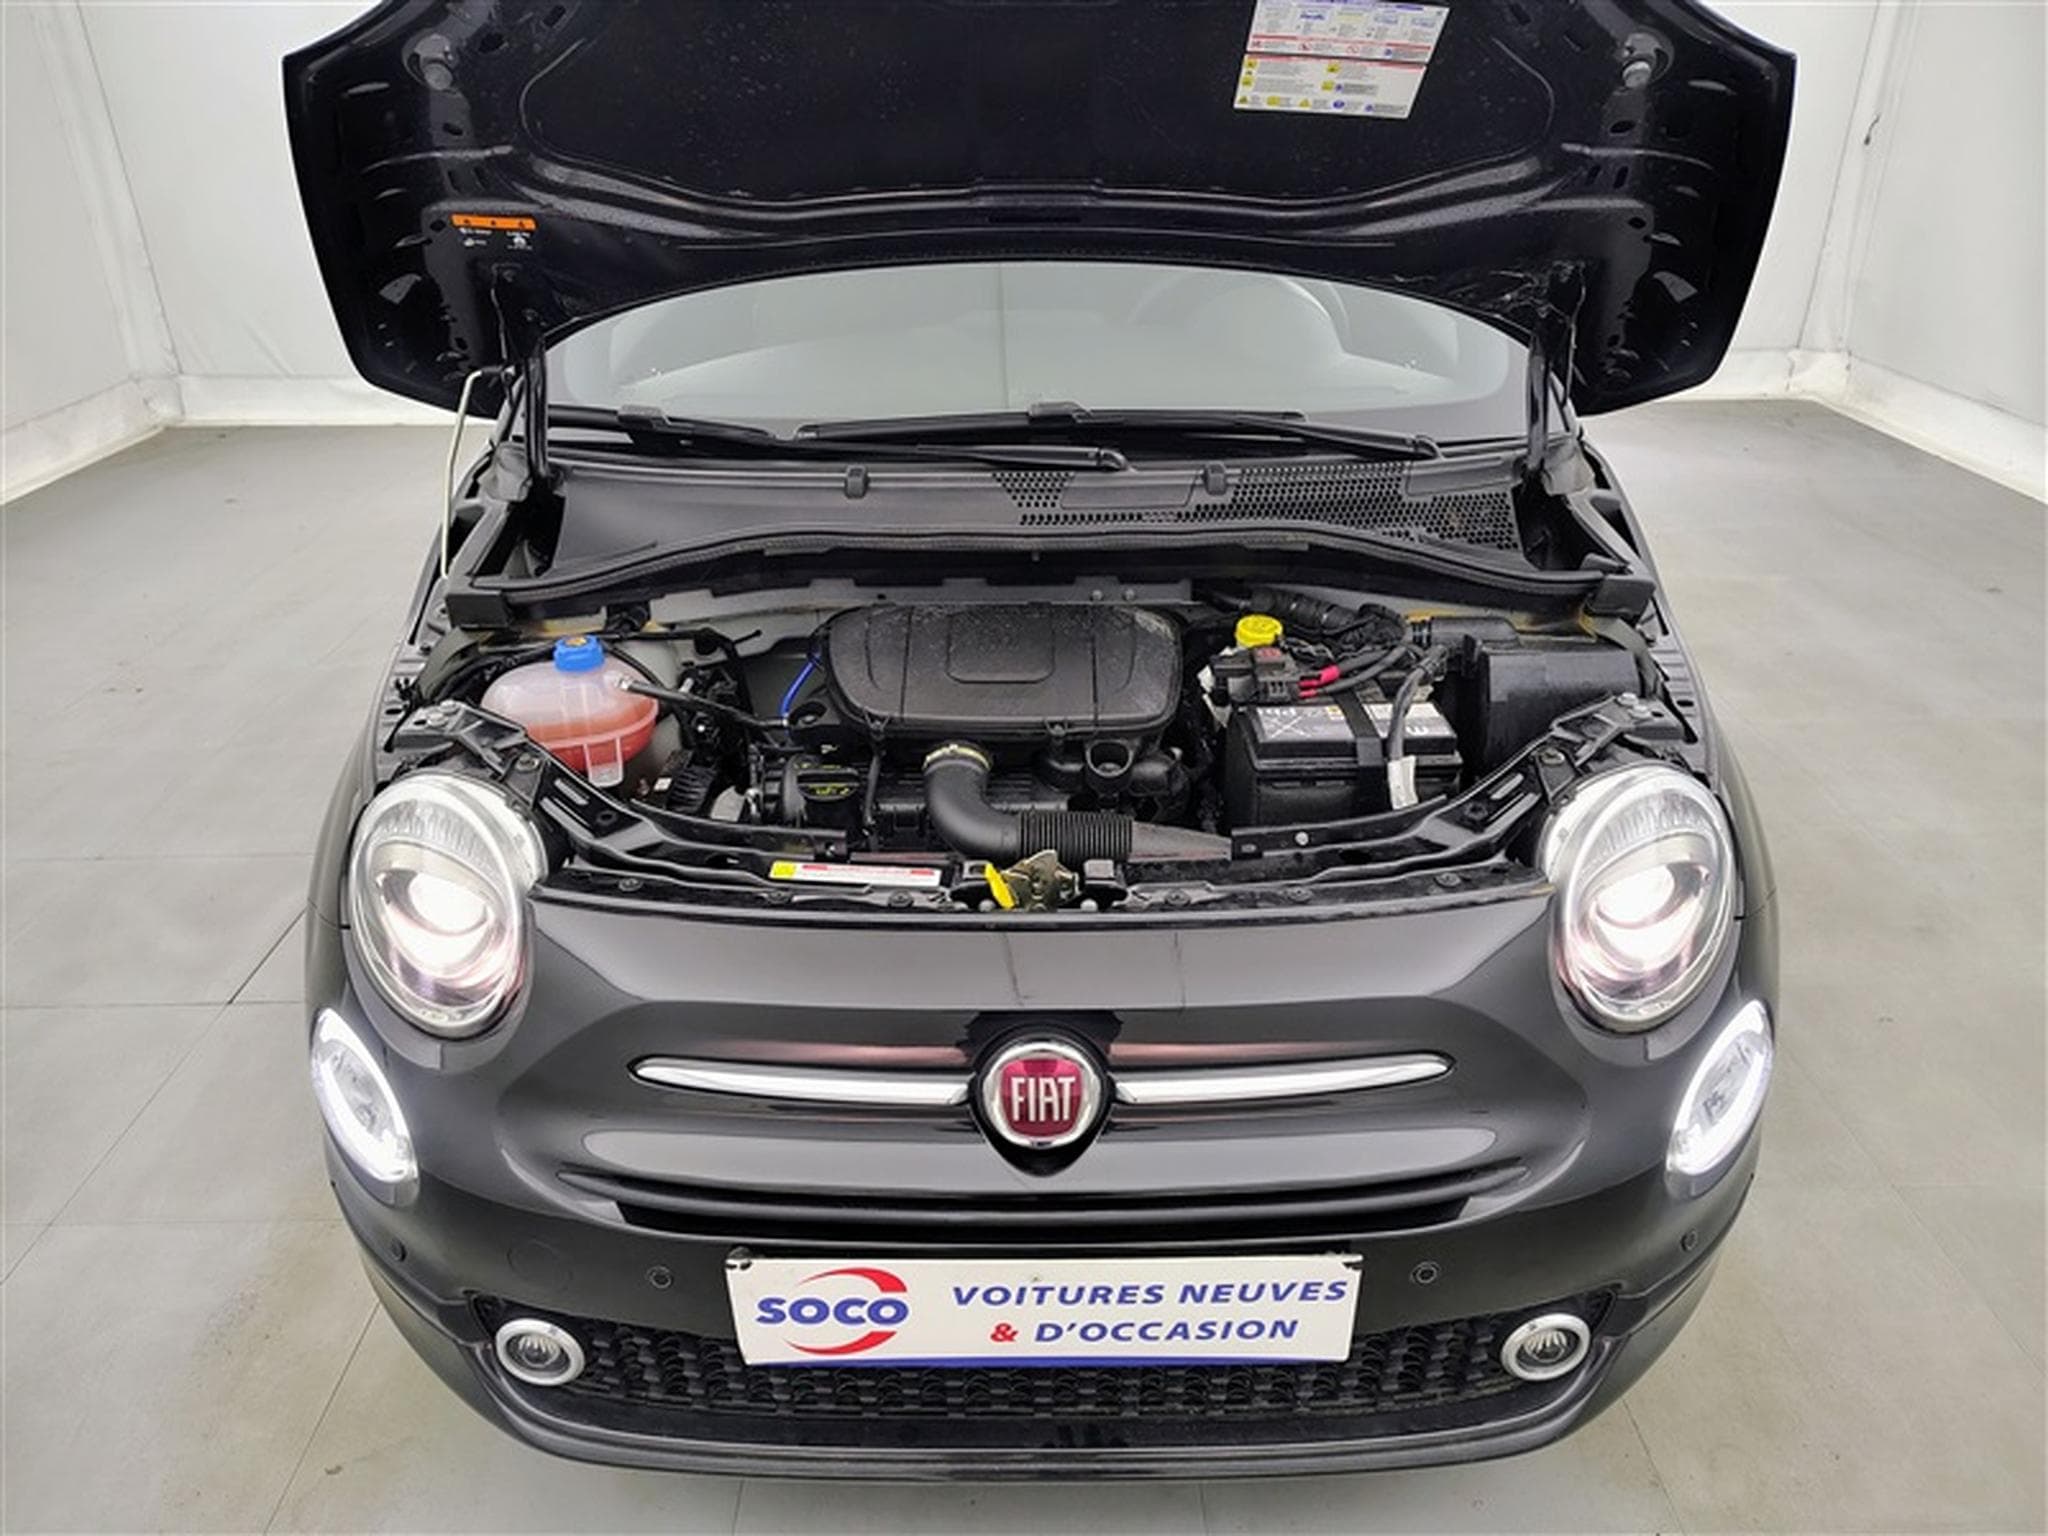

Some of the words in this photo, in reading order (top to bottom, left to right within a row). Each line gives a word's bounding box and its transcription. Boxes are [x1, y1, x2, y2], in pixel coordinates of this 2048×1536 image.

[1010, 1076, 1076, 1122] FIAT
[952, 1284, 1165, 1306] VOITURES
[1178, 1281, 1347, 1304] NEUVES
[755, 1297, 909, 1326] SOCO
[990, 1322, 1018, 1342] &
[1034, 1319, 1298, 1342] D'OCCASION
